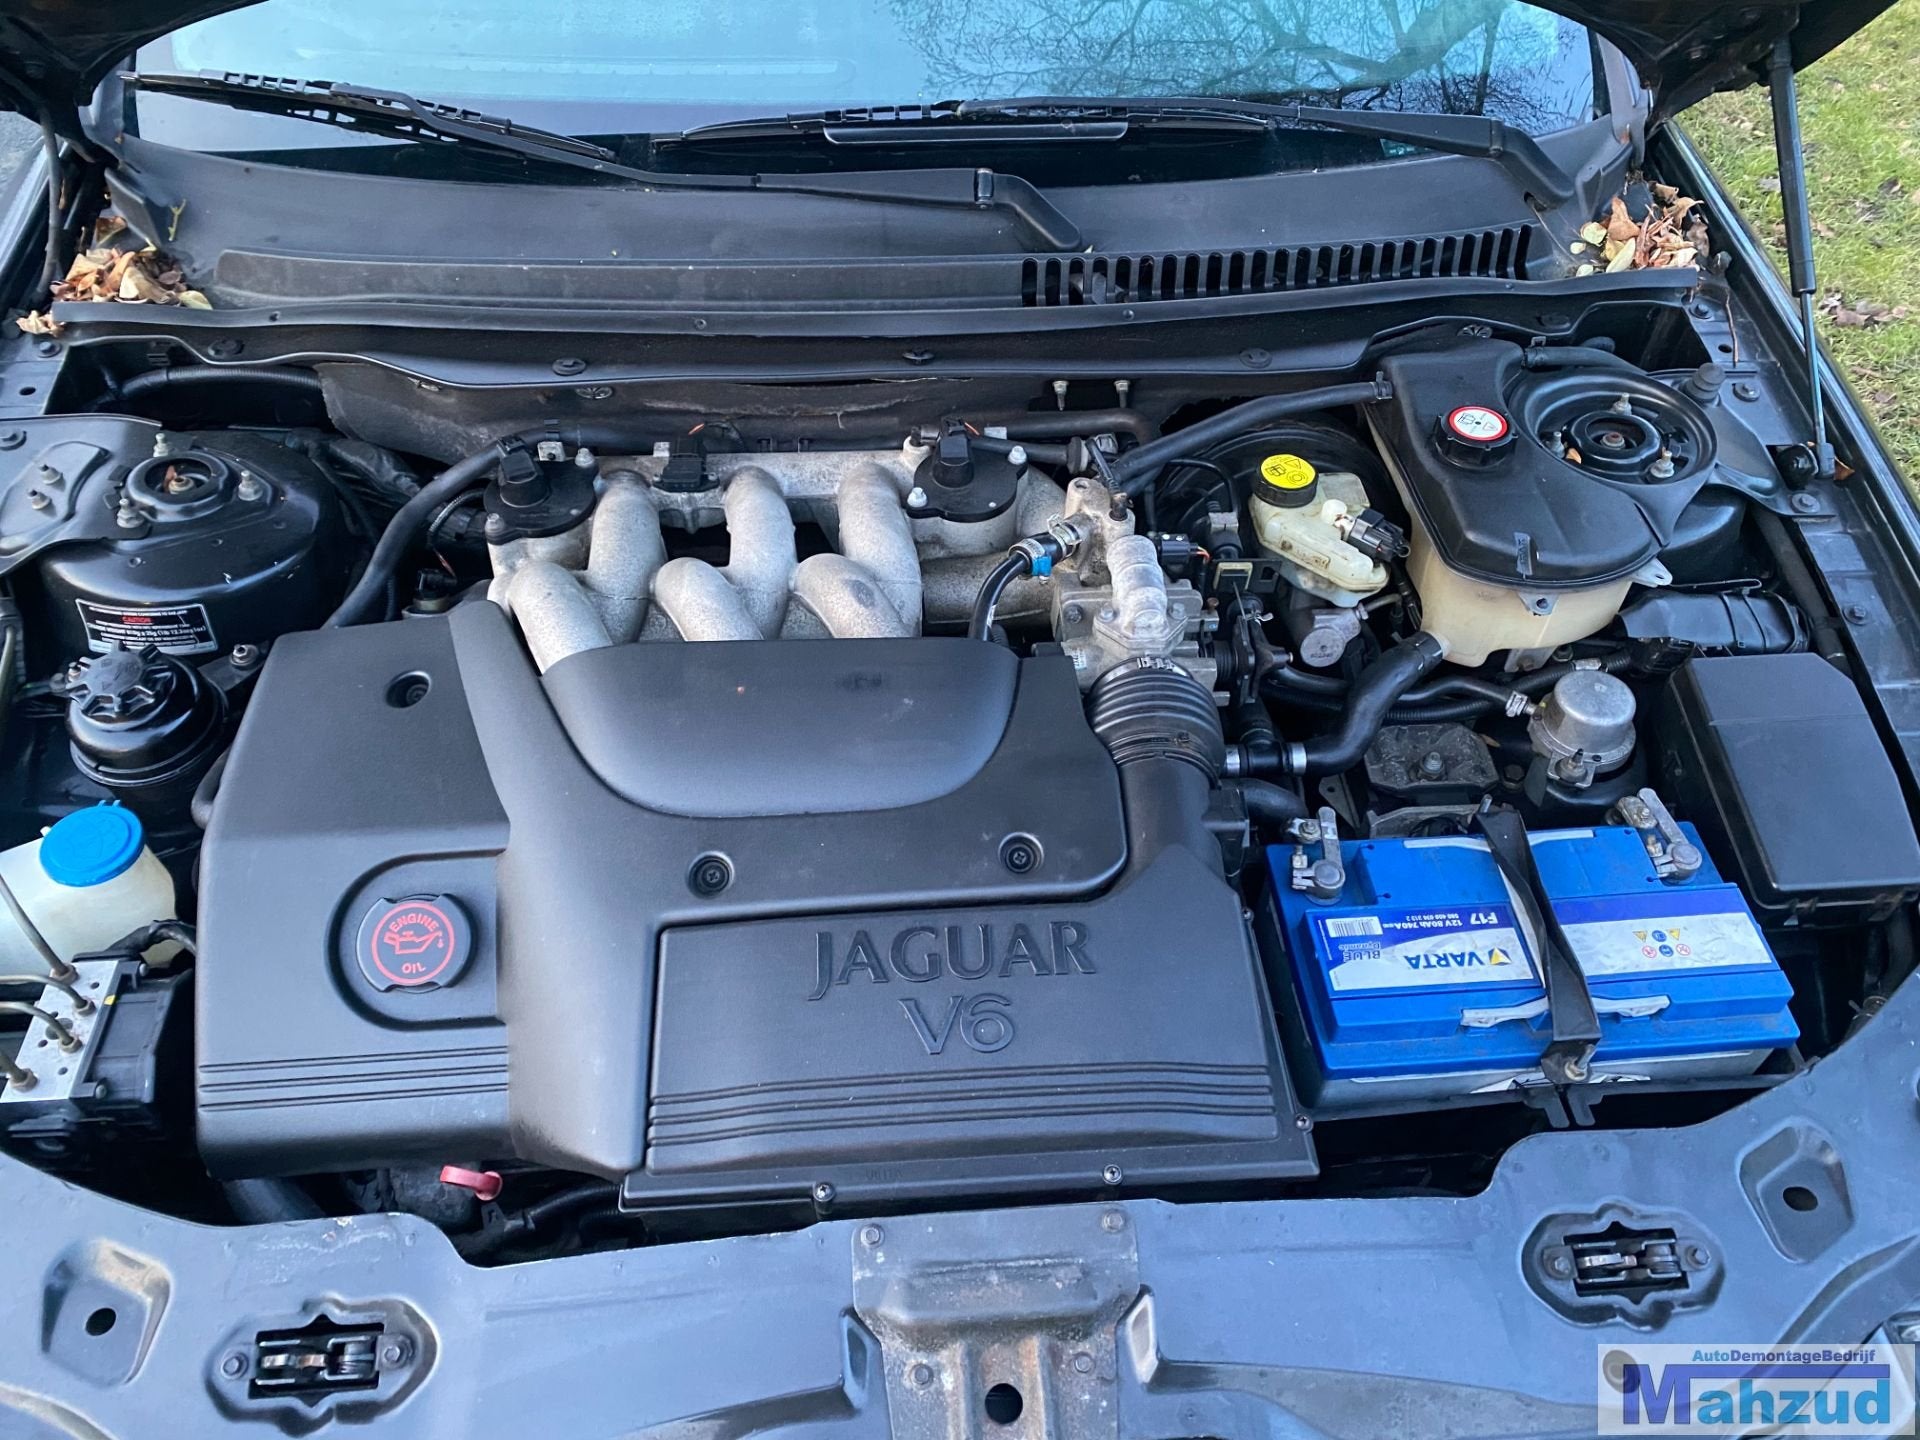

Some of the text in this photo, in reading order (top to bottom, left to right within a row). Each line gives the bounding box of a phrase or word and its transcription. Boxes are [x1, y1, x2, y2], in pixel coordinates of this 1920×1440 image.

[389, 913, 439, 932] ENGINE
[1470, 912, 1498, 925] F17
[807, 920, 1096, 1001] JAGUAR
[1343, 949, 1380, 963] BLUE
[1405, 950, 1484, 969] VARTA
[402, 962, 426, 974] OIL
[897, 992, 1015, 1055] V6
